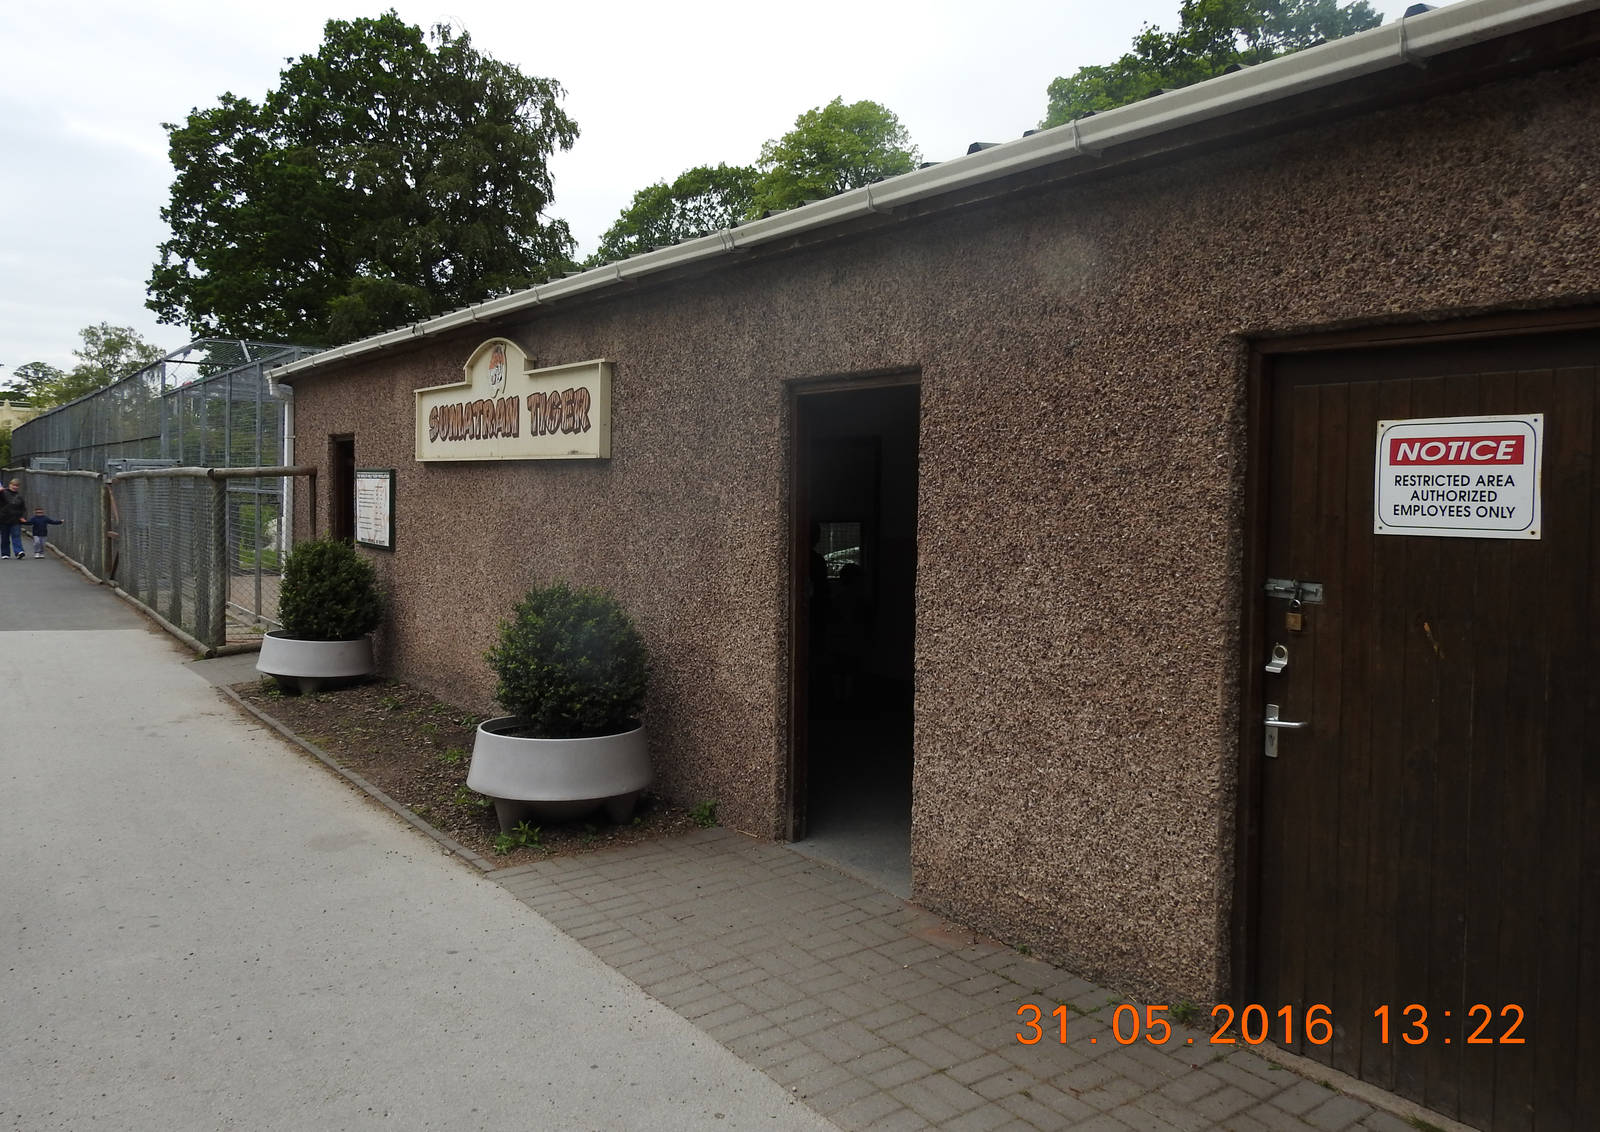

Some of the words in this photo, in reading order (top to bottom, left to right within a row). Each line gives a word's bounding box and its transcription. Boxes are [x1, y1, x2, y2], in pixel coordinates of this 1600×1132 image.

[429, 395, 520, 443] SUMATRAN
[527, 386, 592, 437] TIGER
[1396, 440, 1517, 462] NOTICE
[1394, 475, 1470, 487] RESTRICTED
[1475, 475, 1515, 487] AREA
[1410, 490, 1498, 502] AUTHORIZED
[1393, 504, 1471, 517] EMPLOYEES
[1475, 506, 1516, 519] ONLY
